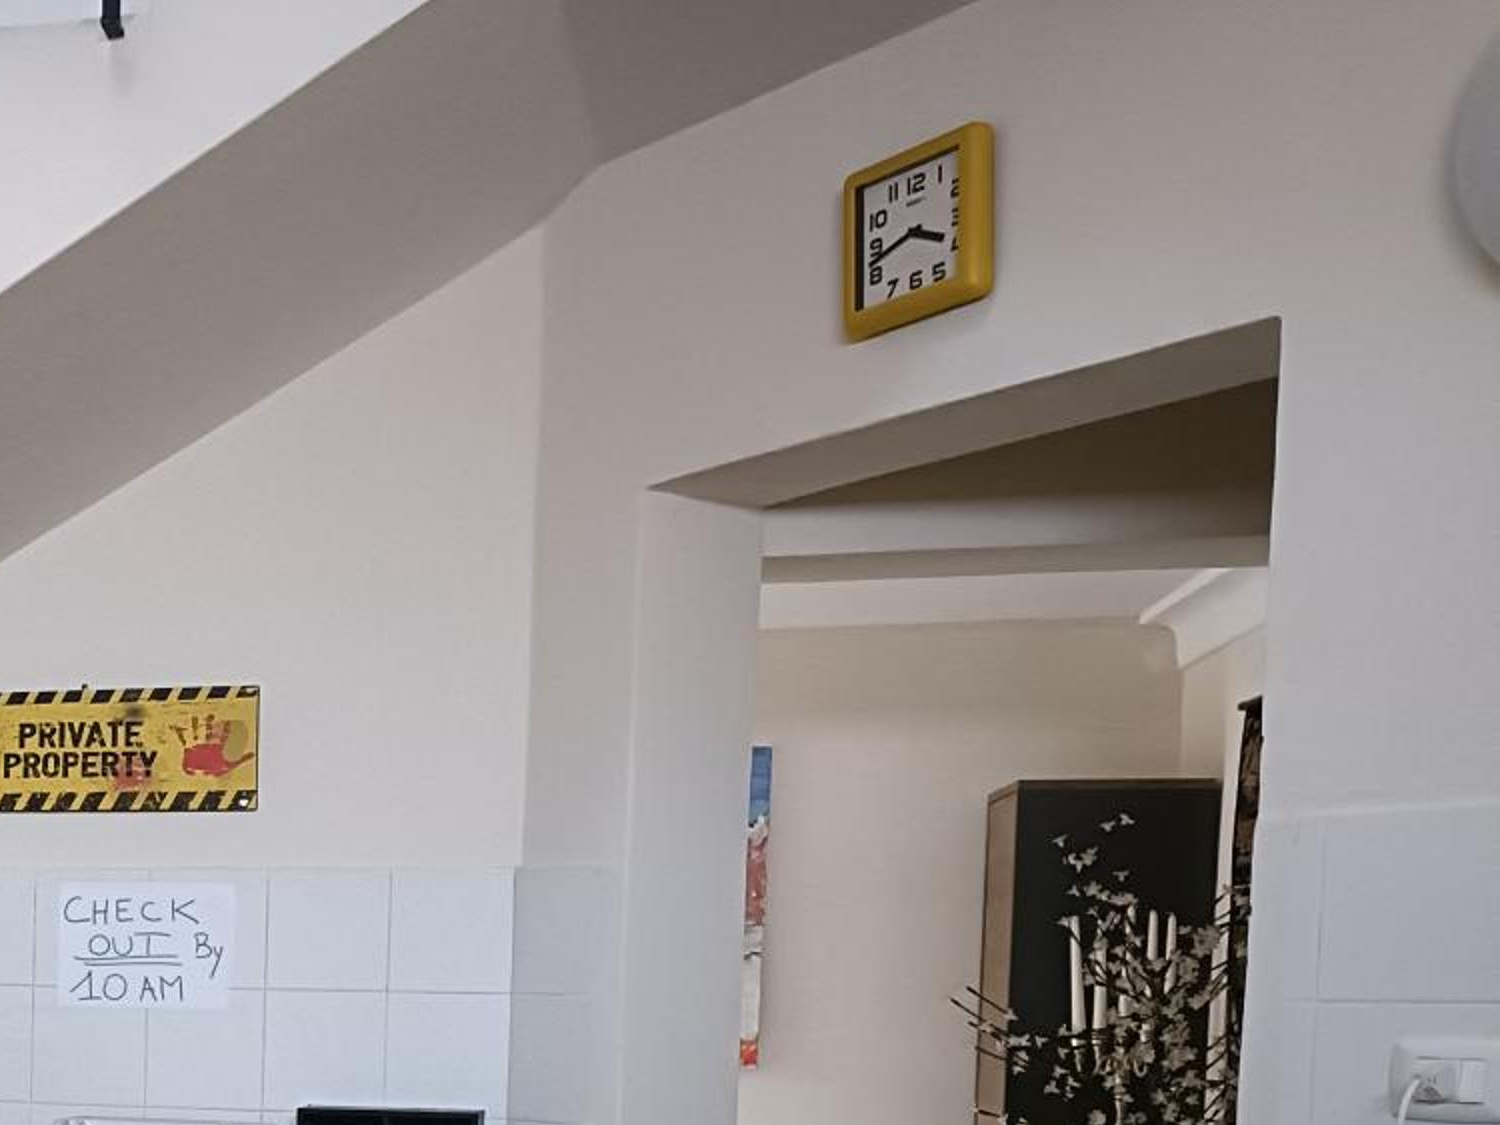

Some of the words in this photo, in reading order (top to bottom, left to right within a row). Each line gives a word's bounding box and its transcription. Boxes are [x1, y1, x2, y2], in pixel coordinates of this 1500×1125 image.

[907, 173, 926, 196] 12
[938, 164, 943, 184] 1
[888, 182, 899, 204] 11
[869, 209, 888, 232] 10
[869, 237, 883, 258] 9
[869, 265, 883, 286] 8
[909, 270, 923, 291] 6
[932, 262, 946, 282] 5
[887, 278, 899, 299] 7
[18, 720, 143, 749] PRIVATE
[2, 750, 158, 779] PROPERTY
[63, 896, 199, 925] CHECK
[88, 931, 172, 959] OUT
[69, 970, 128, 1001] 10
[139, 975, 183, 1002] AM
